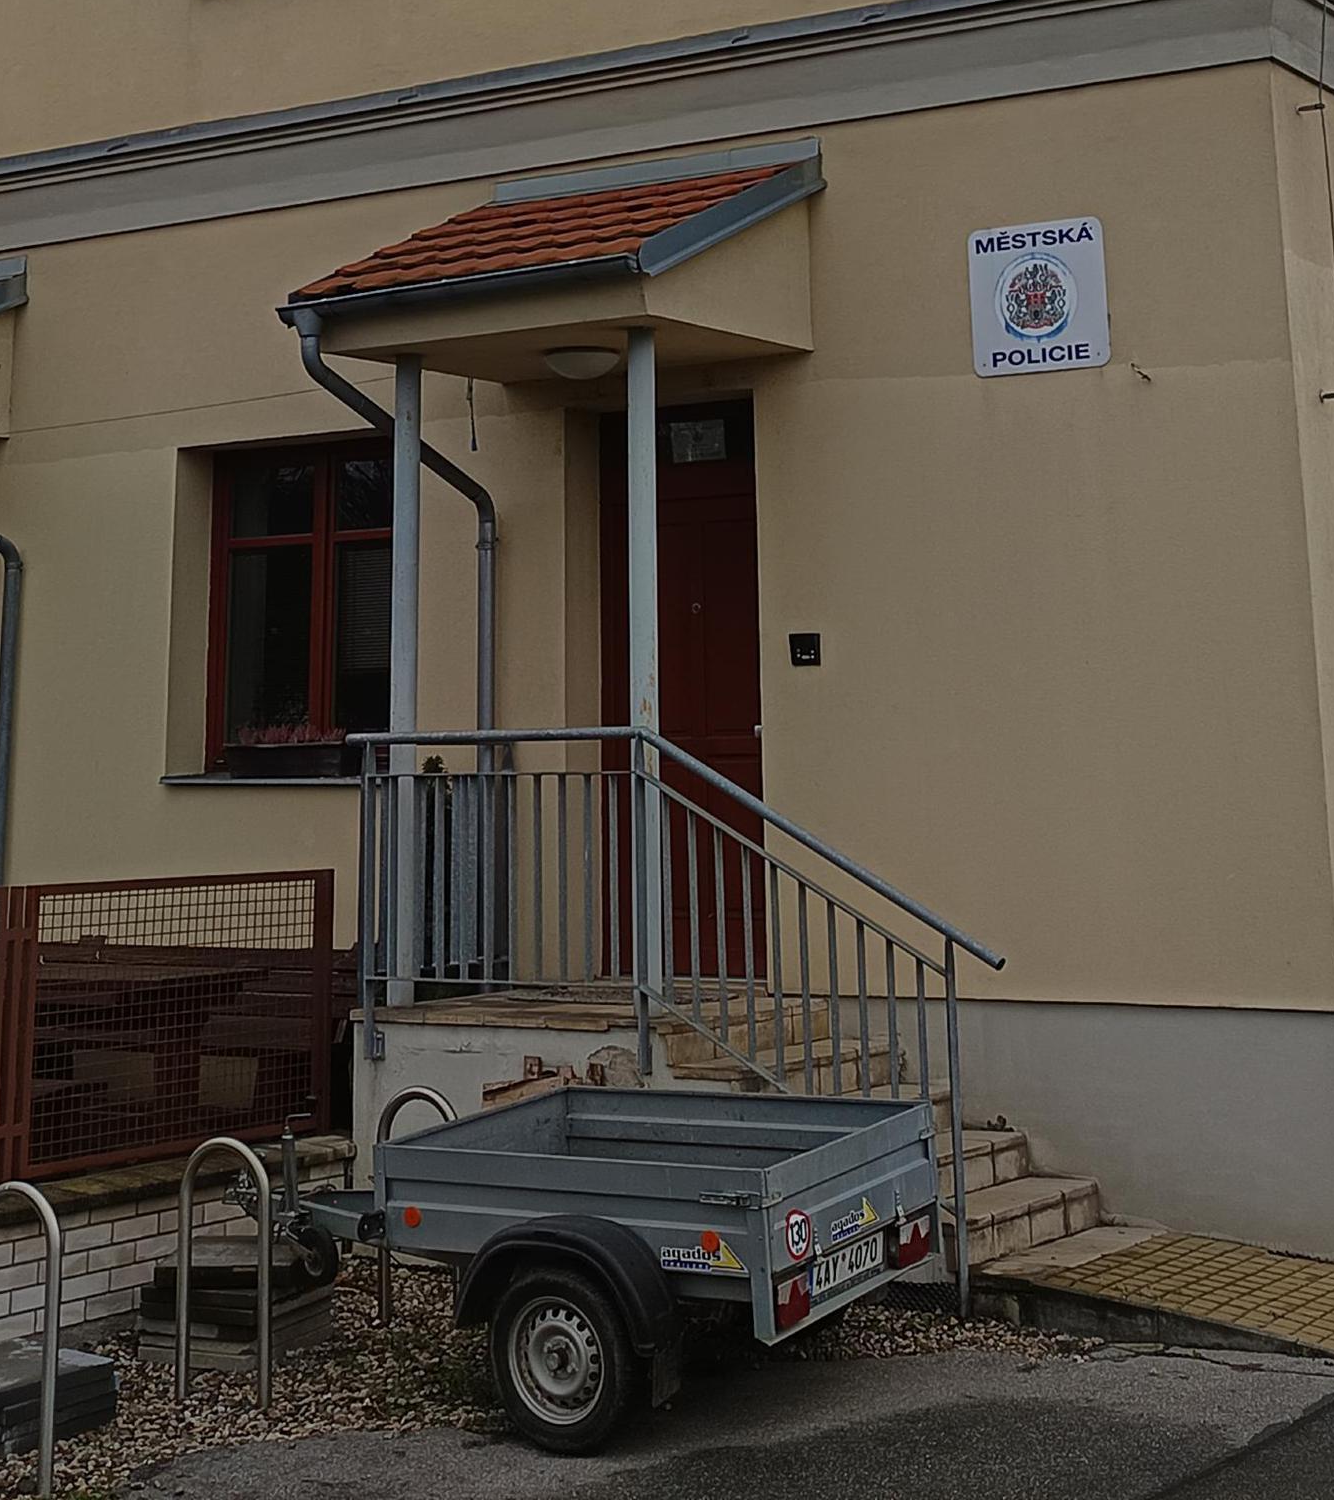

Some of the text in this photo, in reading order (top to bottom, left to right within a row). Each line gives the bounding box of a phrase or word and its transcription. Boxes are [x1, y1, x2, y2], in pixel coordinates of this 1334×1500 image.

[975, 222, 1094, 255] MĚSTSKÁ
[992, 343, 1090, 368] POLICIE
[790, 1218, 806, 1249] 130
[662, 1247, 721, 1262] agados
[815, 1255, 839, 1290] 4AY
[848, 1236, 878, 1275] 4070
